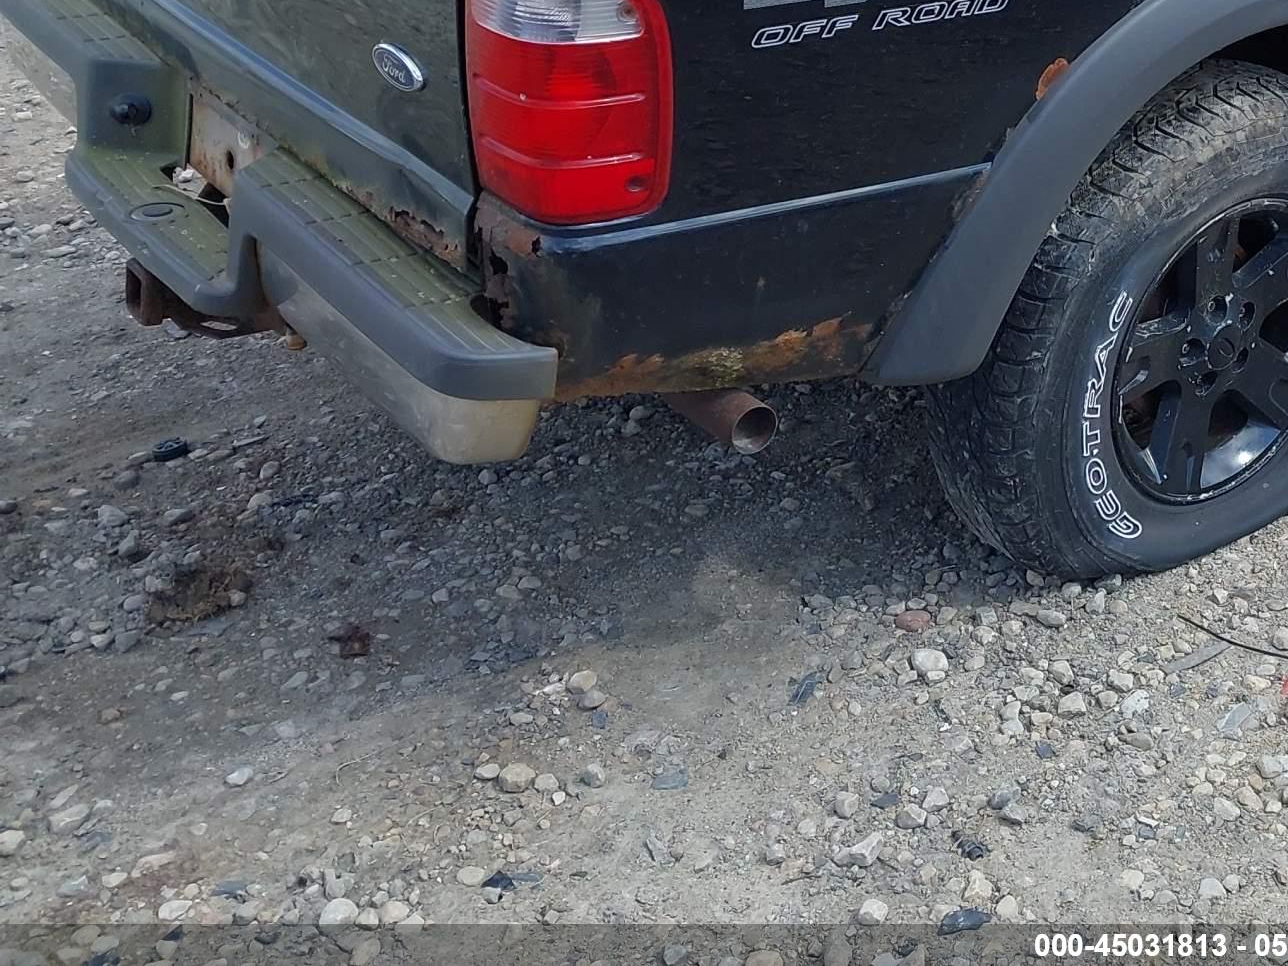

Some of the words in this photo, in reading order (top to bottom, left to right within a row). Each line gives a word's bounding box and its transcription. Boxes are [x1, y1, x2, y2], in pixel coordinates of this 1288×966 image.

[752, 15, 858, 48] OFF
[382, 54, 405, 83] Ford
[1083, 290, 1143, 539] GEOTRAC
